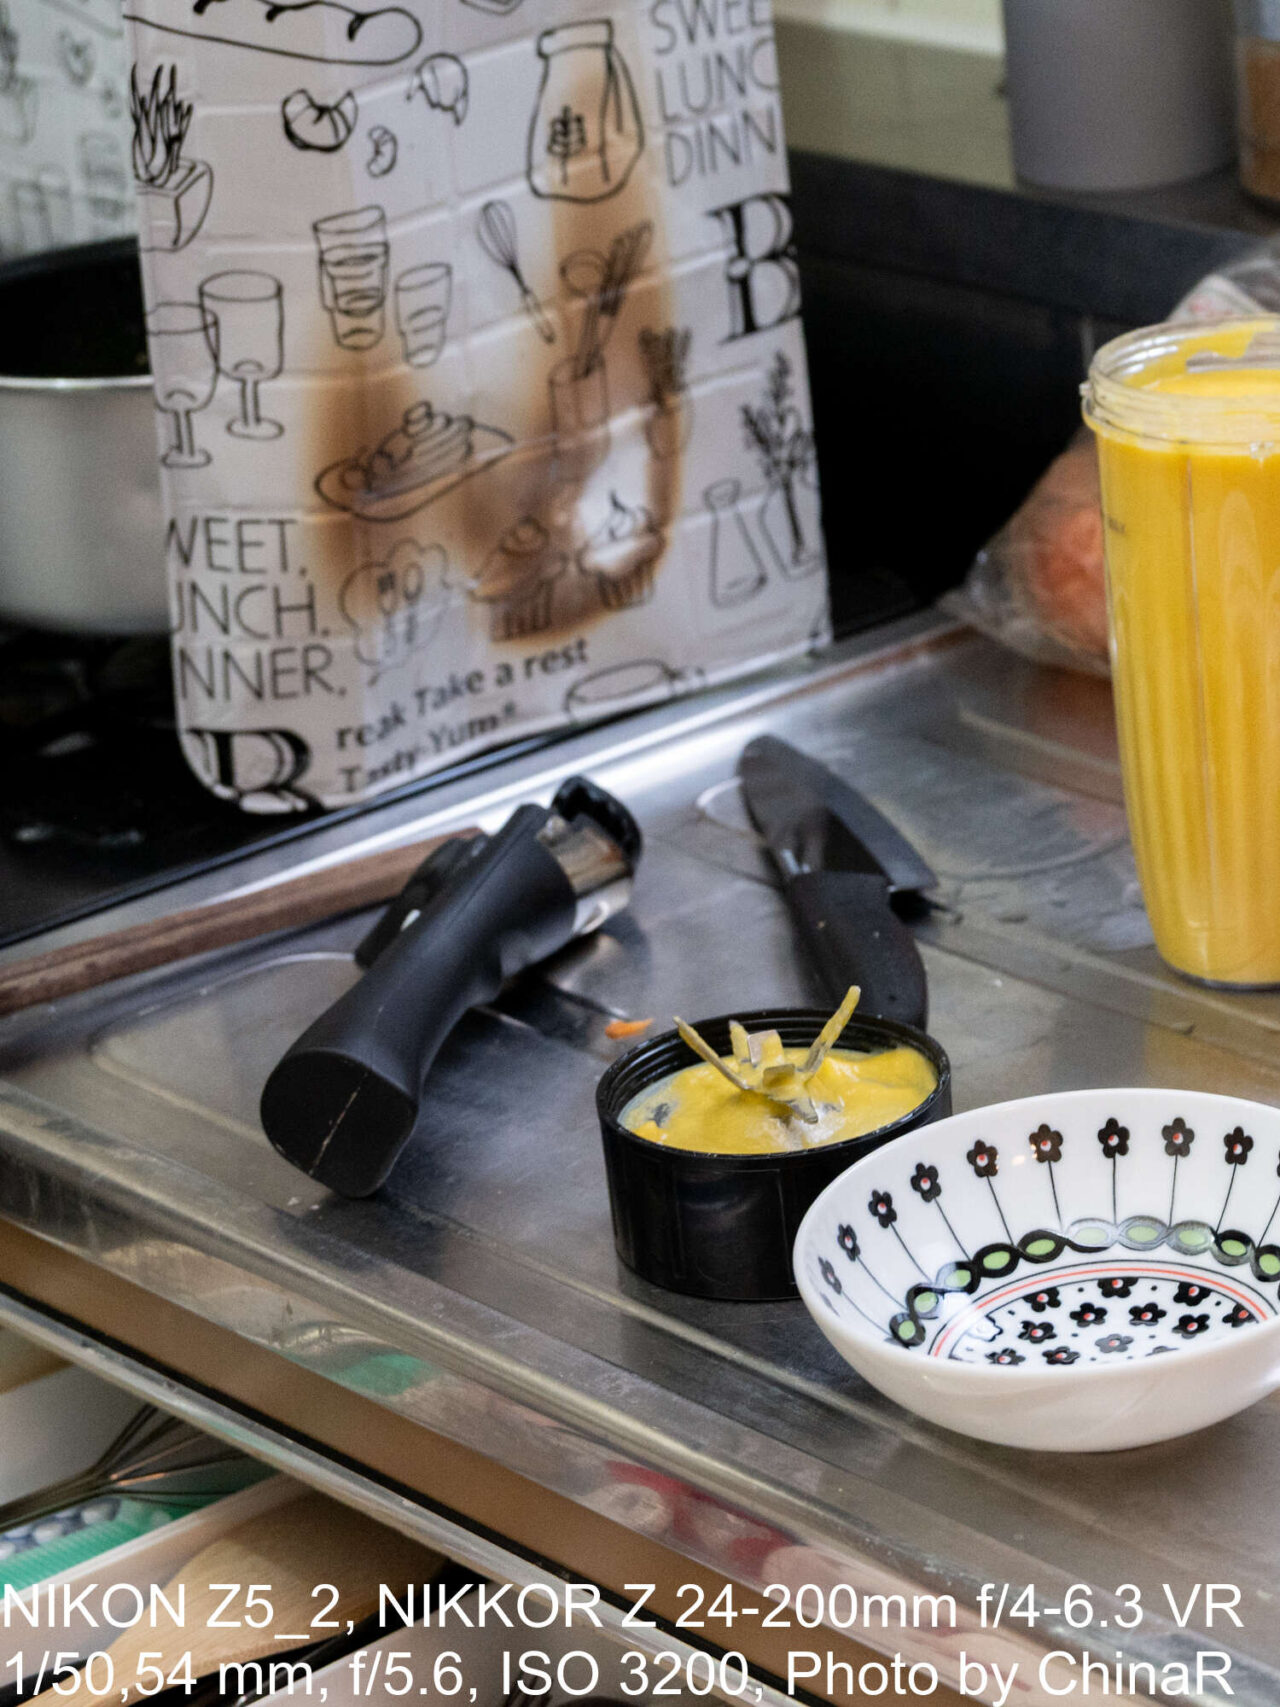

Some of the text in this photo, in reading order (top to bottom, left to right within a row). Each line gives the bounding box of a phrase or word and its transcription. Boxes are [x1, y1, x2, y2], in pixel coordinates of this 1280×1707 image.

[664, 106, 777, 188] DINN
[414, 668, 485, 717] Take
[496, 661, 515, 689] a
[523, 637, 588, 680] rest
